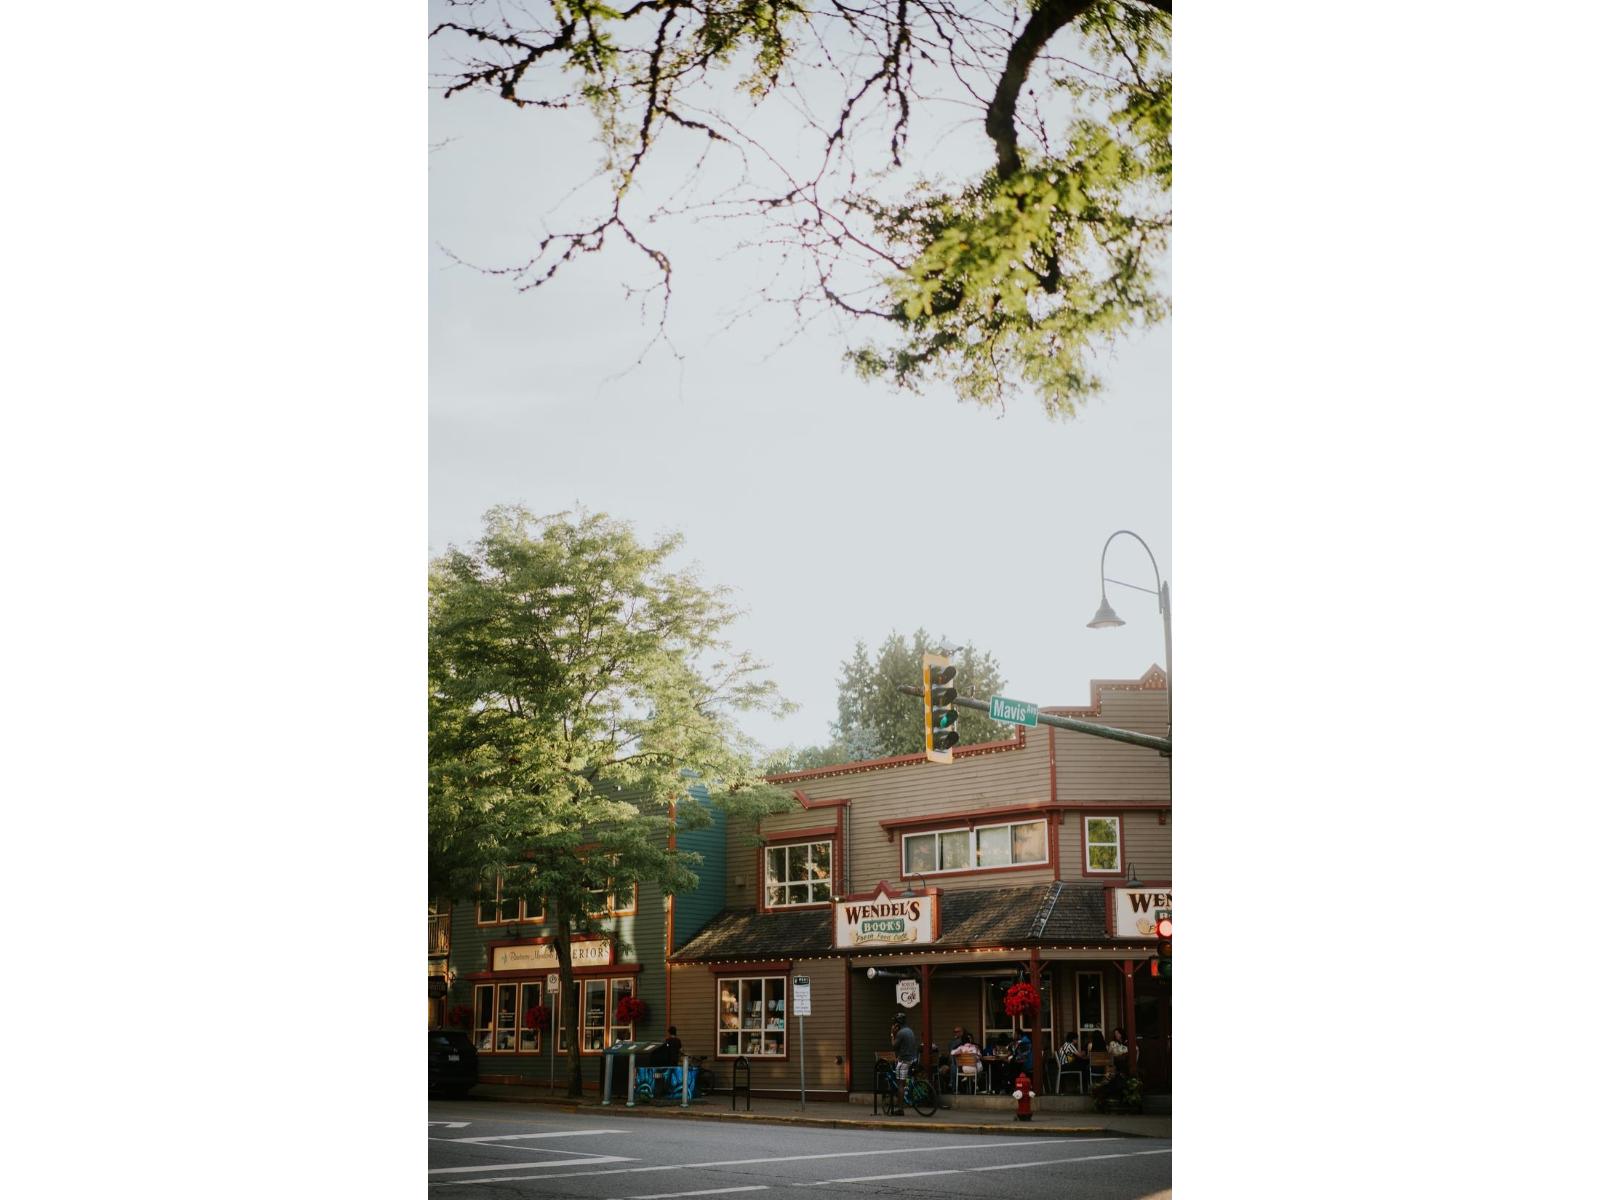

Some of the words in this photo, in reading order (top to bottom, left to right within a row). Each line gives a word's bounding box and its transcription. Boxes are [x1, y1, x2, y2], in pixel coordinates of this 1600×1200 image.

[993, 699, 1026, 721] Mavis
[845, 901, 920, 925] WENDEL'S
[863, 921, 901, 932] BOOKS
